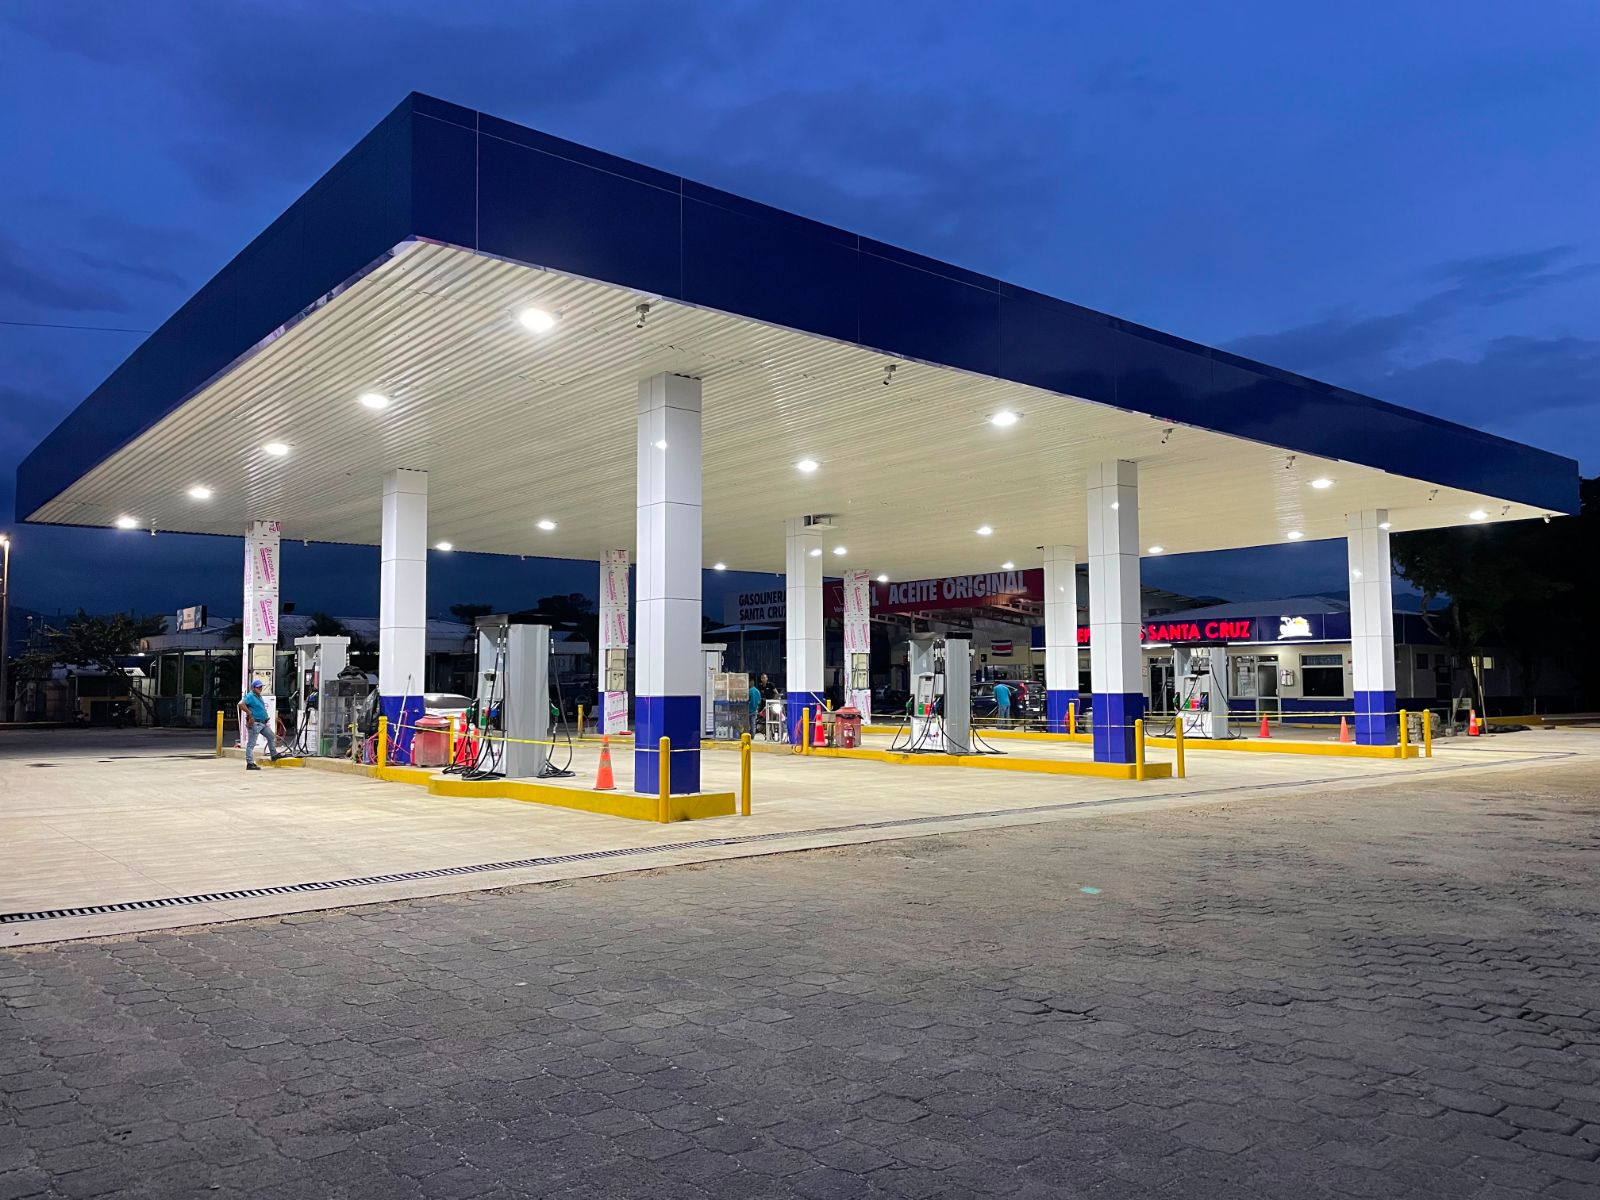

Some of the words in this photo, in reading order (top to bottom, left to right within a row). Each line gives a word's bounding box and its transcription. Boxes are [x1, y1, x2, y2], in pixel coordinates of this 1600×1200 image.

[868, 586, 880, 607] L
[888, 580, 938, 606] ACEITE
[942, 571, 1028, 600] ORIGINAL
[739, 607, 766, 621] SANTA
[1148, 623, 1200, 641] SANTA
[1204, 621, 1251, 639] CRUZ
